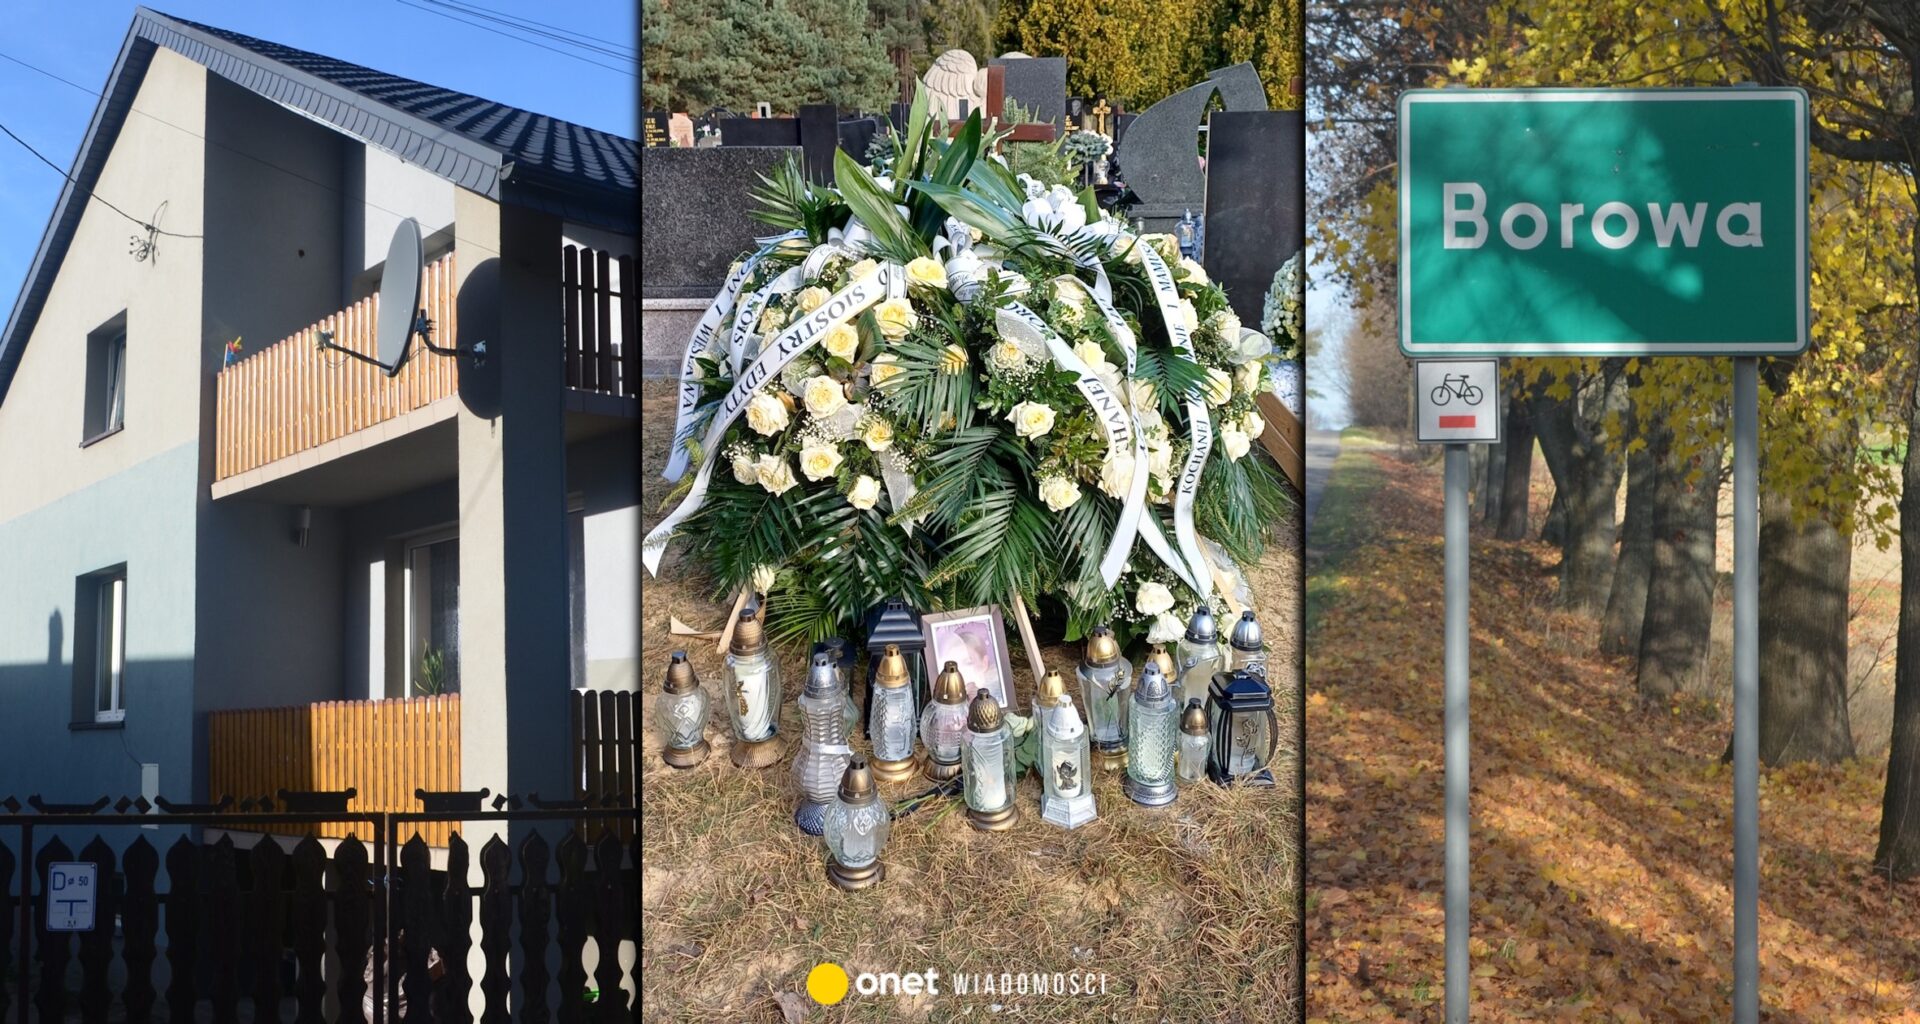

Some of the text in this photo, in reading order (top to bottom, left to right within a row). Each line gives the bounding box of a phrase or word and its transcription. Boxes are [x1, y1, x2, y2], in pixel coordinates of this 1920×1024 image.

[1443, 182, 1763, 250] Borowa
[777, 285, 866, 362] SIOSTRY
[724, 361, 768, 419] EDYTY
[1182, 420, 1208, 494] KOCHANEJ
[53, 871, 66, 891] D
[78, 875, 89, 887] 50
